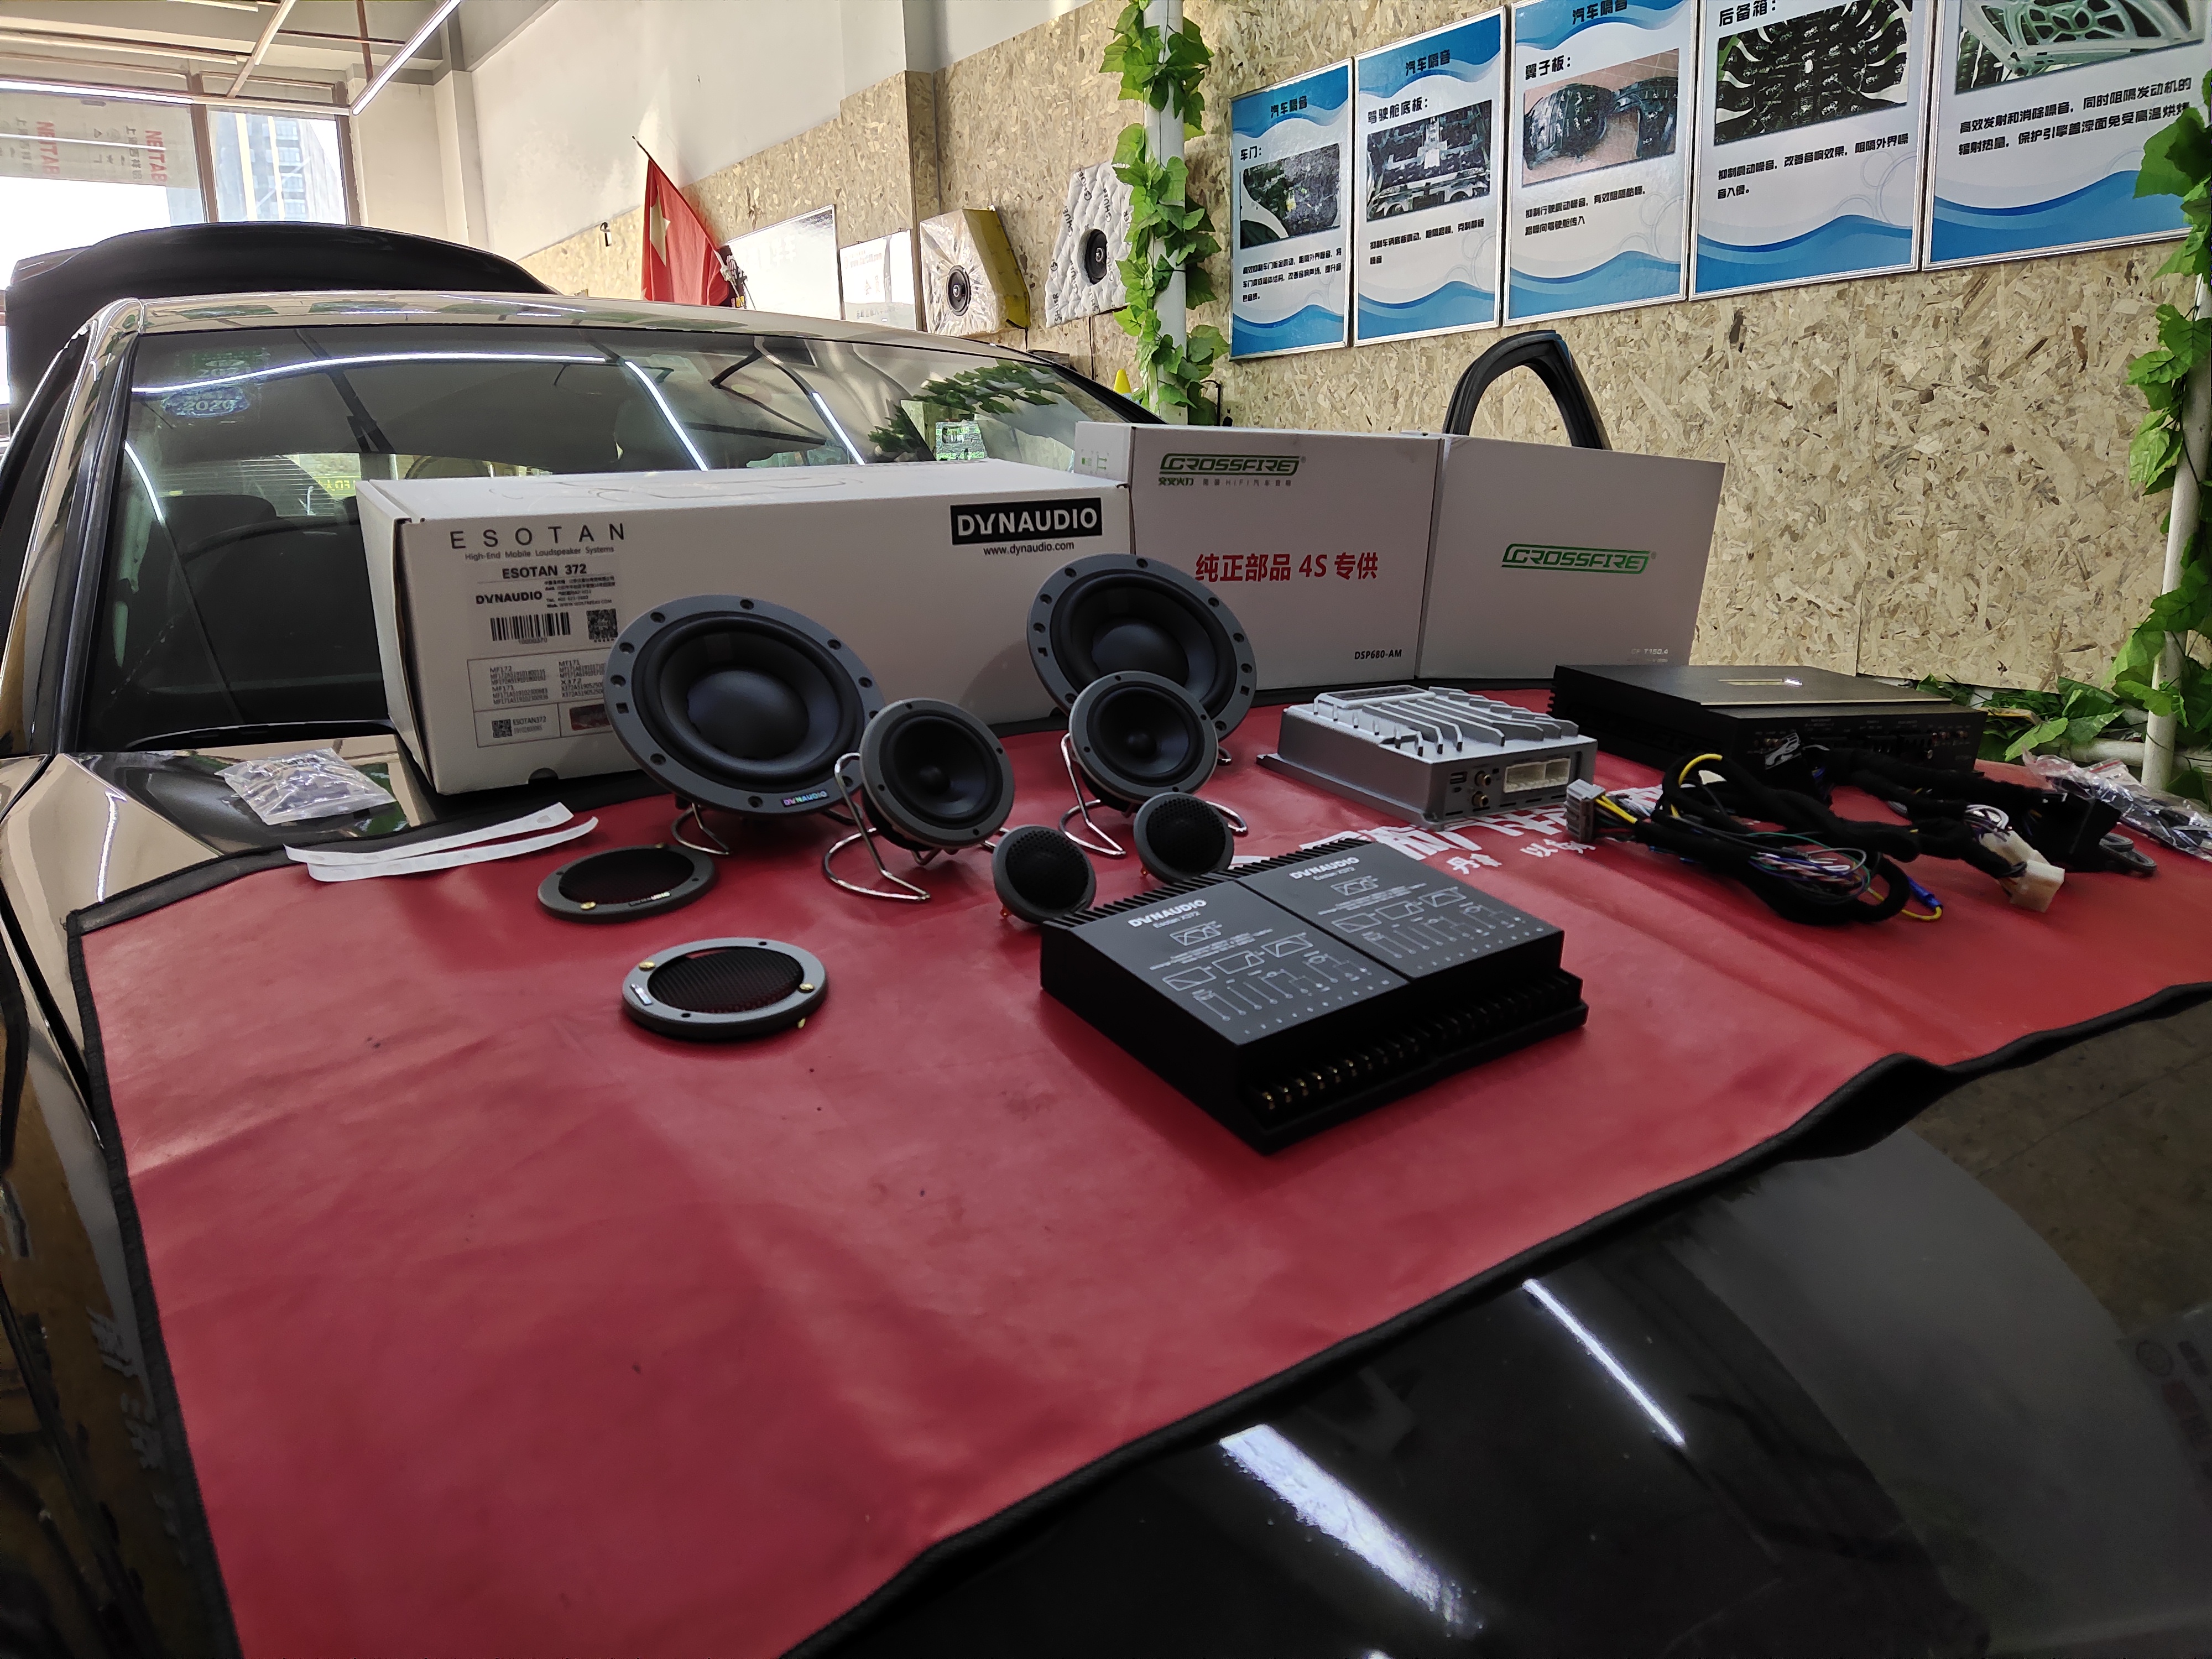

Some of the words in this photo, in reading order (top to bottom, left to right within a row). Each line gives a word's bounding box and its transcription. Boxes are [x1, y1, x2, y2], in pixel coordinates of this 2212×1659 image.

[1405, 49, 1451, 76] 汽车隔音
[1270, 95, 1307, 118] 汽车隔音
[1164, 456, 1298, 473] CROSSFIRE
[957, 507, 1097, 536] DYNAUDIO
[450, 523, 625, 549] ESOTAN
[465, 552, 500, 561] High-End
[535, 547, 581, 557] Loudspeaker
[585, 545, 614, 554] Systems
[983, 541, 1075, 555] www.dynaudio.com
[1505, 546, 1649, 572] CROSSFIRE
[502, 565, 558, 579] ESOTAN
[564, 563, 587, 575] 372
[1195, 553, 1292, 582] 纯正部品
[1298, 554, 1328, 577] 4S
[1334, 552, 1379, 580] 专供
[1354, 649, 1402, 660] DSP680-AM
